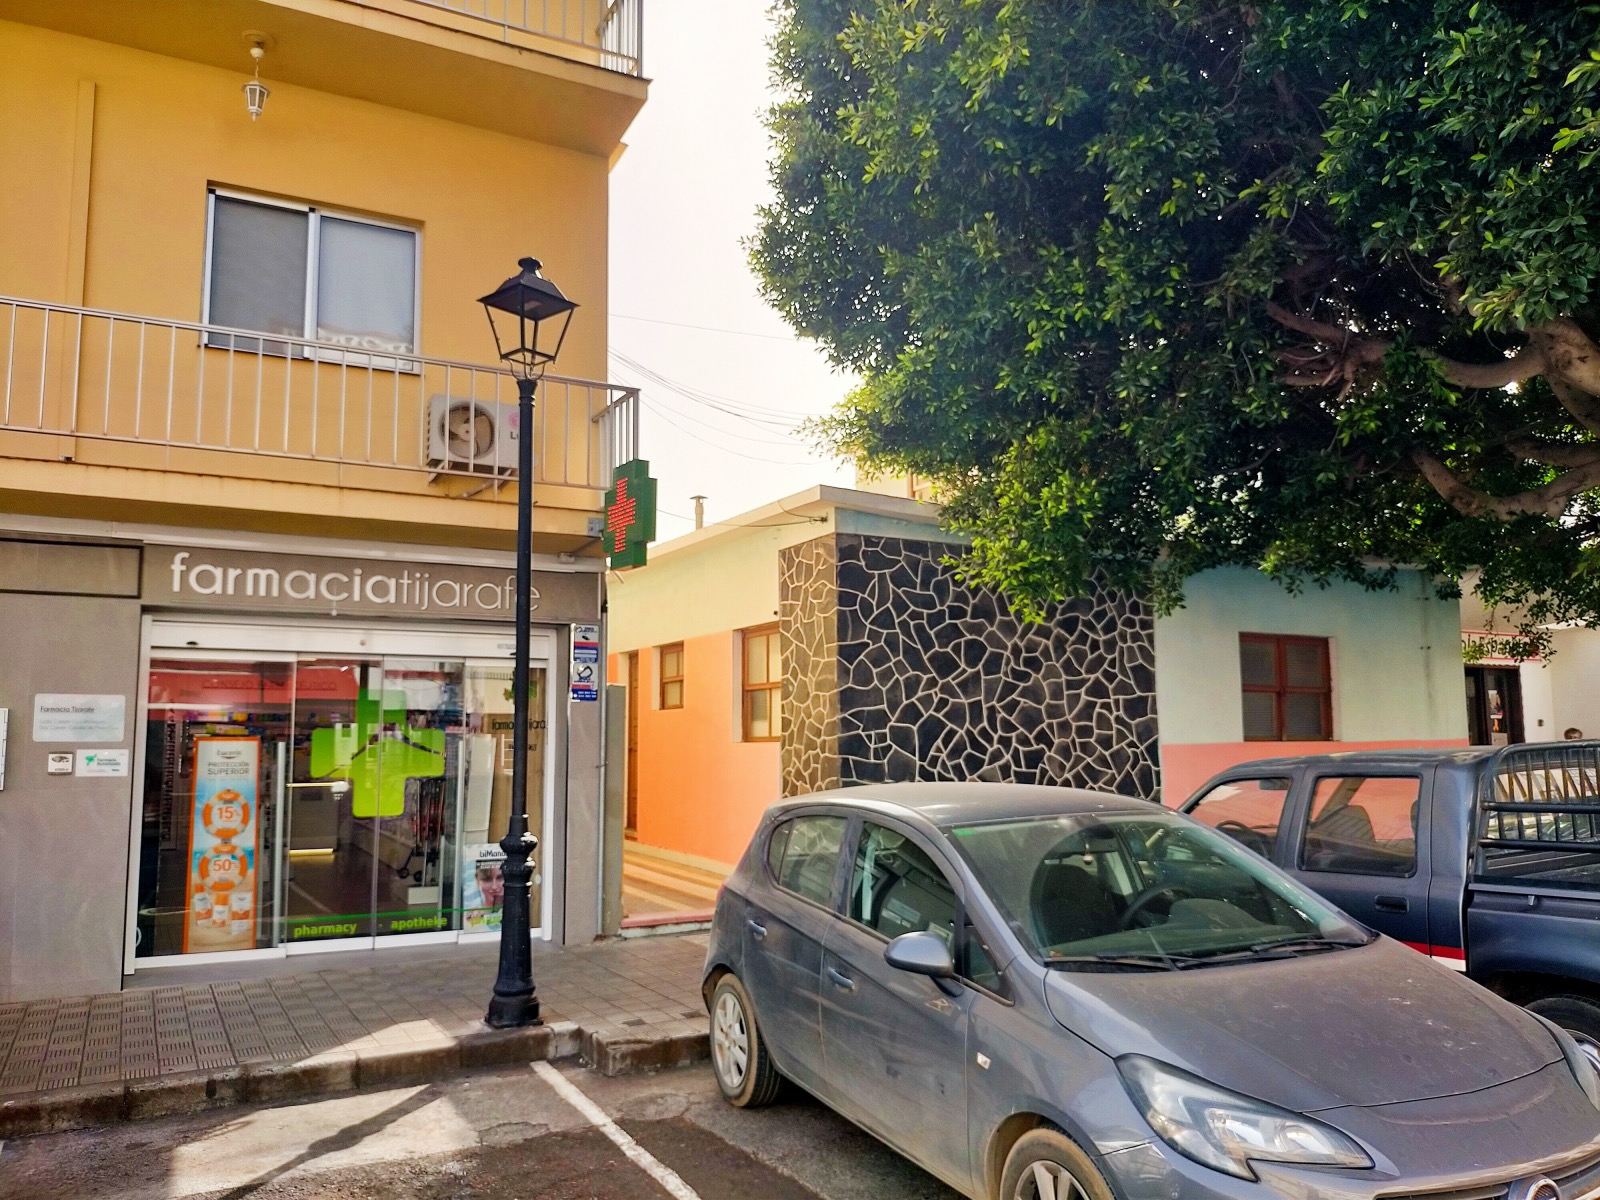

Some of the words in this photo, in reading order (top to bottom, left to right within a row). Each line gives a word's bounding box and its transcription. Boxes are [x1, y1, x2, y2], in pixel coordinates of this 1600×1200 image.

[208, 767, 250, 776] SUPERIOR
[293, 922, 358, 939] pharmacy
[391, 915, 448, 931] apotheke
